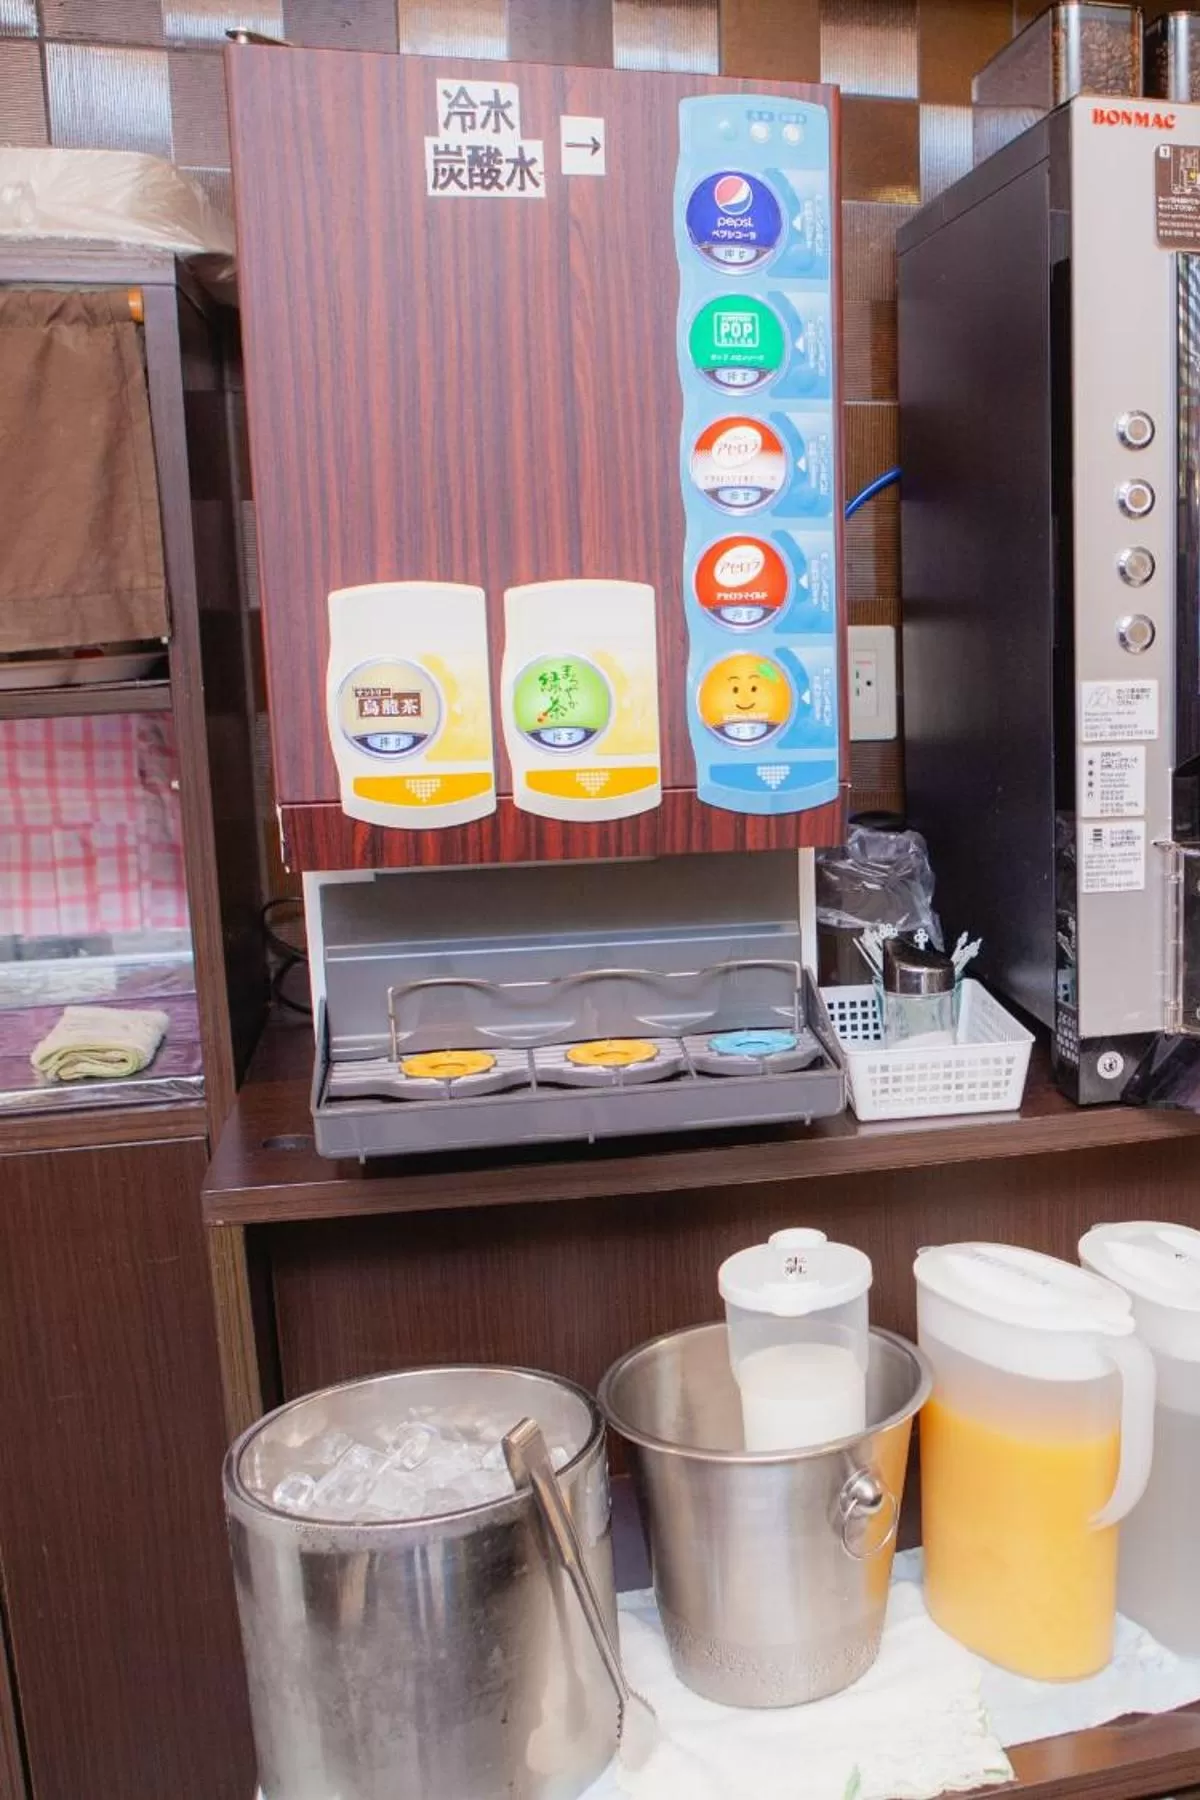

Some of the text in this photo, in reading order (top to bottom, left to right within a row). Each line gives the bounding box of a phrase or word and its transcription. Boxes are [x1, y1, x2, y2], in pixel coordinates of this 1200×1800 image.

[442, 86, 515, 133] 冷水
[1091, 107, 1177, 130] BONMAC
[432, 143, 541, 191] 炭酸水
[717, 216, 754, 228] pepsi
[720, 323, 753, 337] POP
